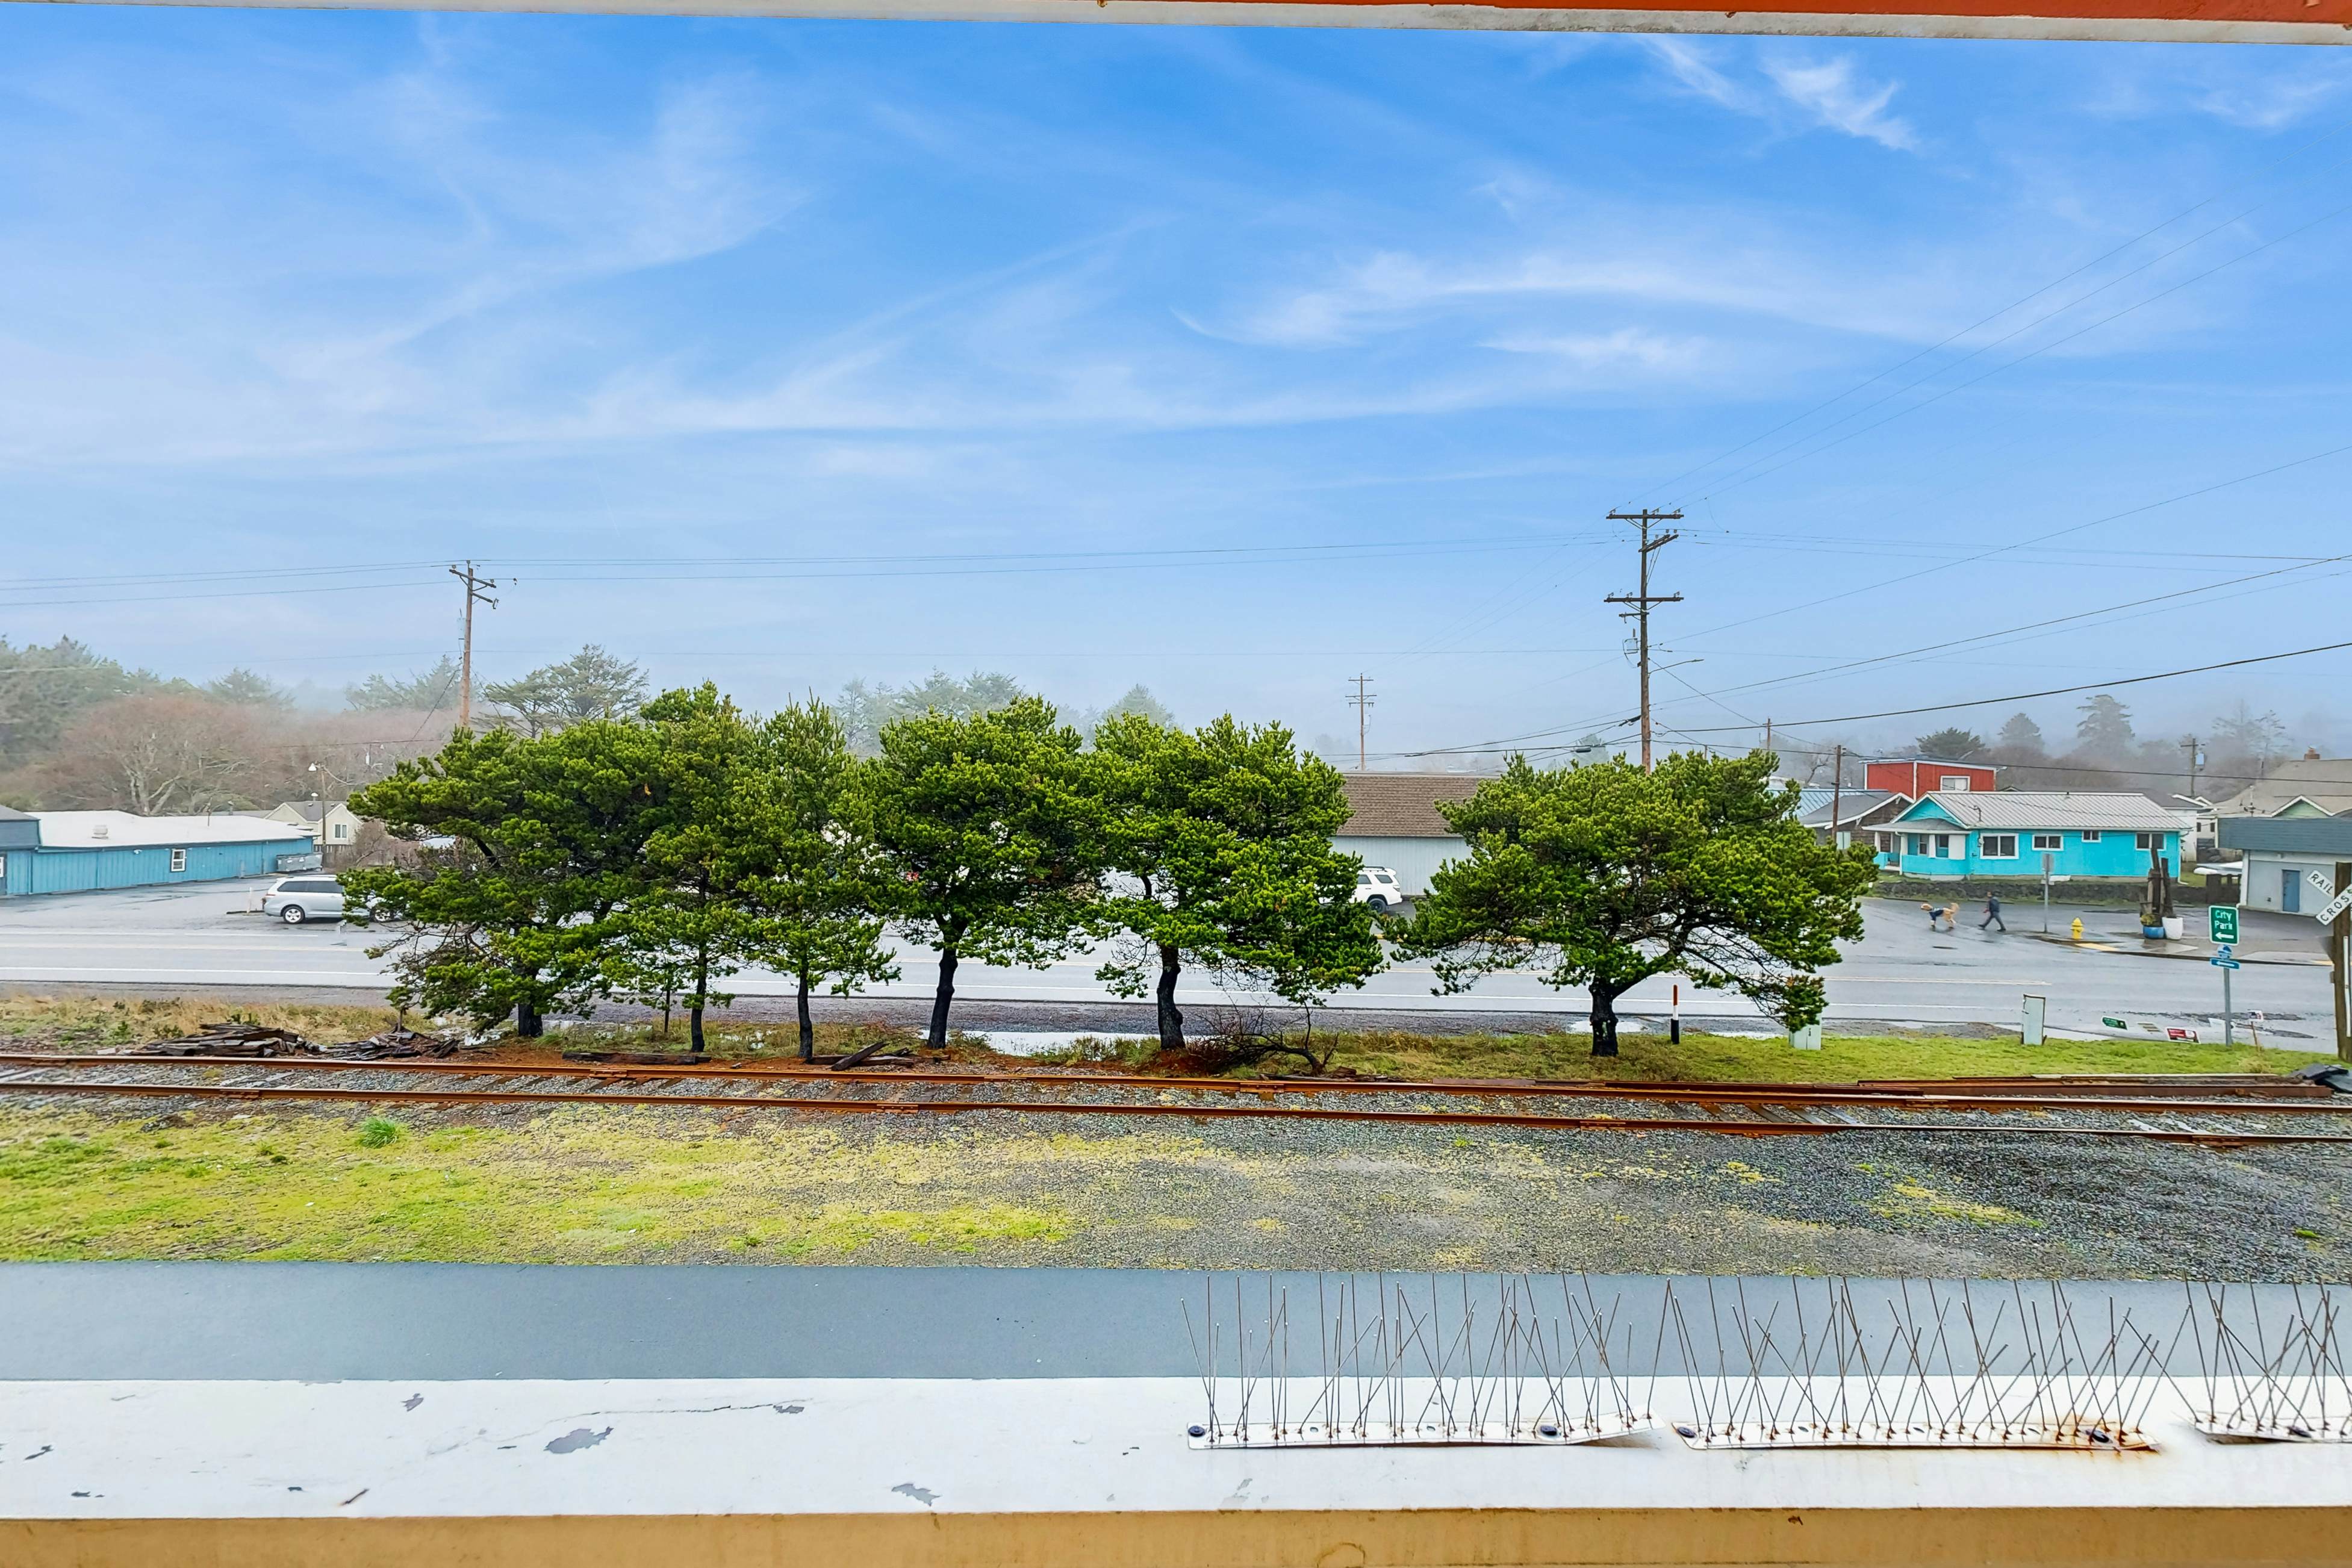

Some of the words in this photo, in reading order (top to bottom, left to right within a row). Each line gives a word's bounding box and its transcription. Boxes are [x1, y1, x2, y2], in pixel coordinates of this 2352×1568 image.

[2311, 874, 2333, 895] RAIL
[2215, 910, 2232, 921] City
[2214, 920, 2233, 930] Park
